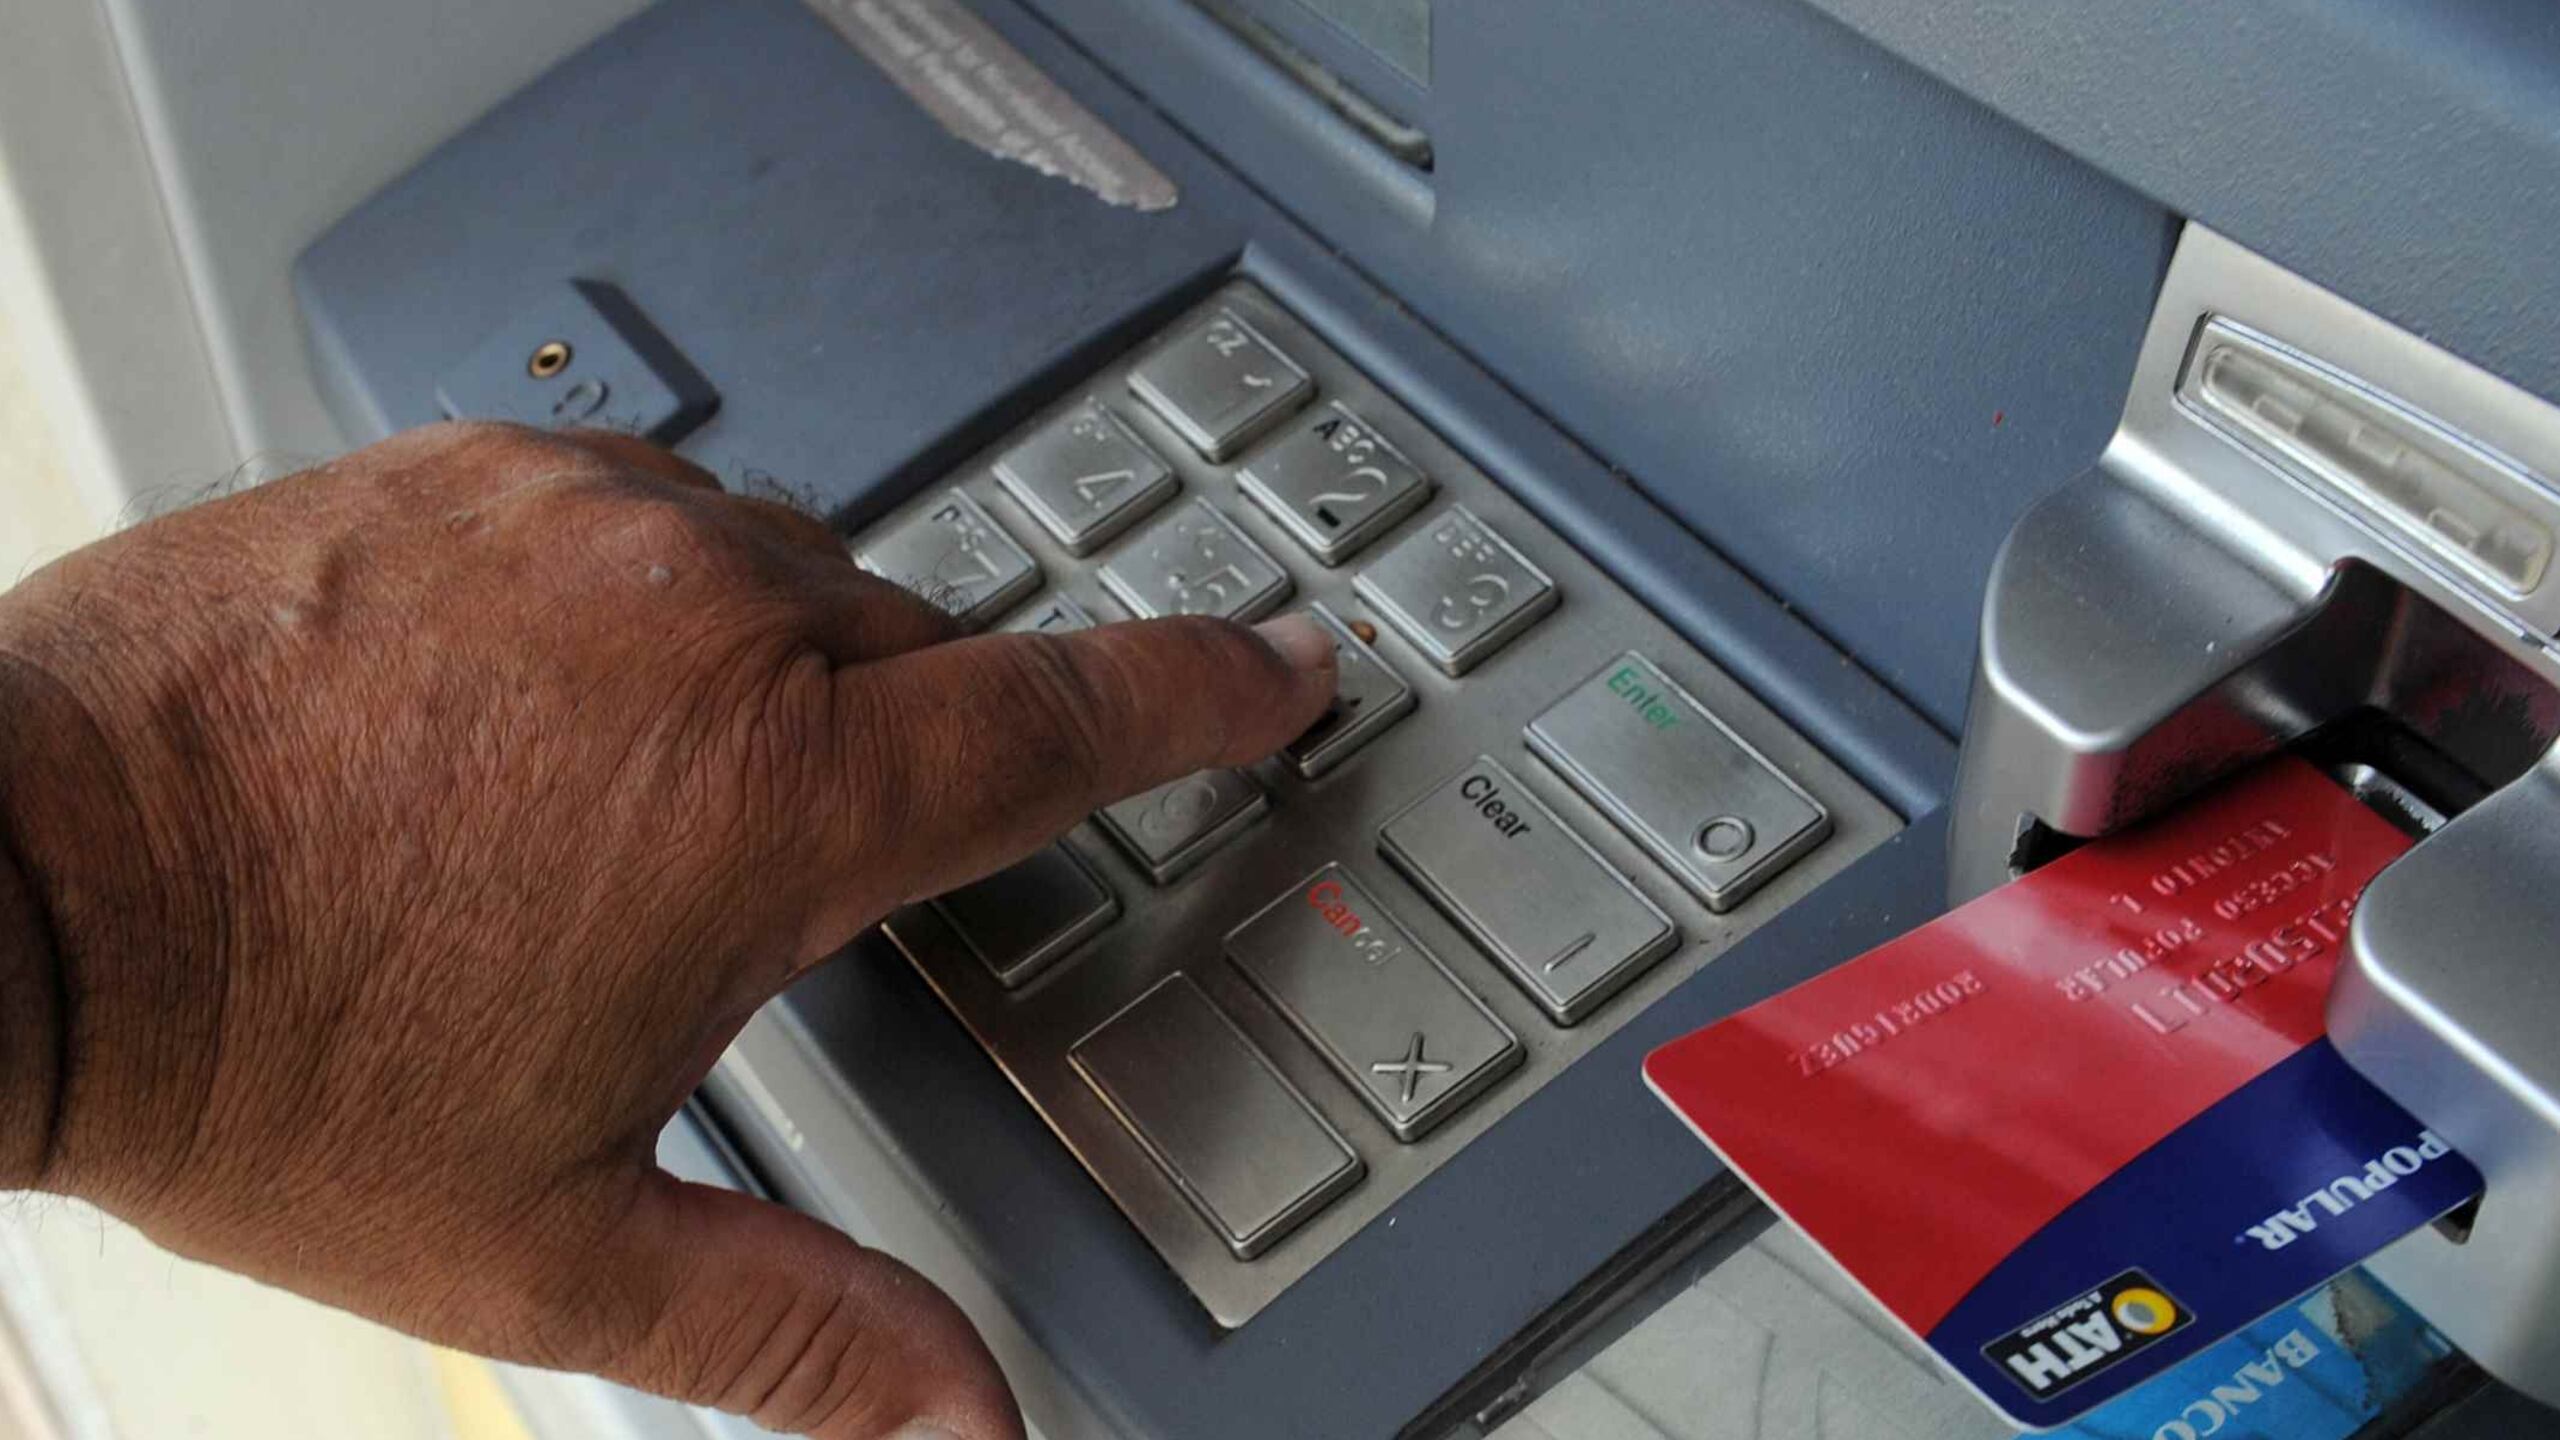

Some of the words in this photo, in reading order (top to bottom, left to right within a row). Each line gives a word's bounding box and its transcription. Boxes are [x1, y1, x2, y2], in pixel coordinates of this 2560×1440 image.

[1607, 666, 1682, 732] Enter
[1461, 774, 1531, 840] Clear
[2058, 915, 2204, 1003] POPULAR
[2246, 1129, 2451, 1250] POPULAR
[2006, 1315, 2125, 1391] ATH
